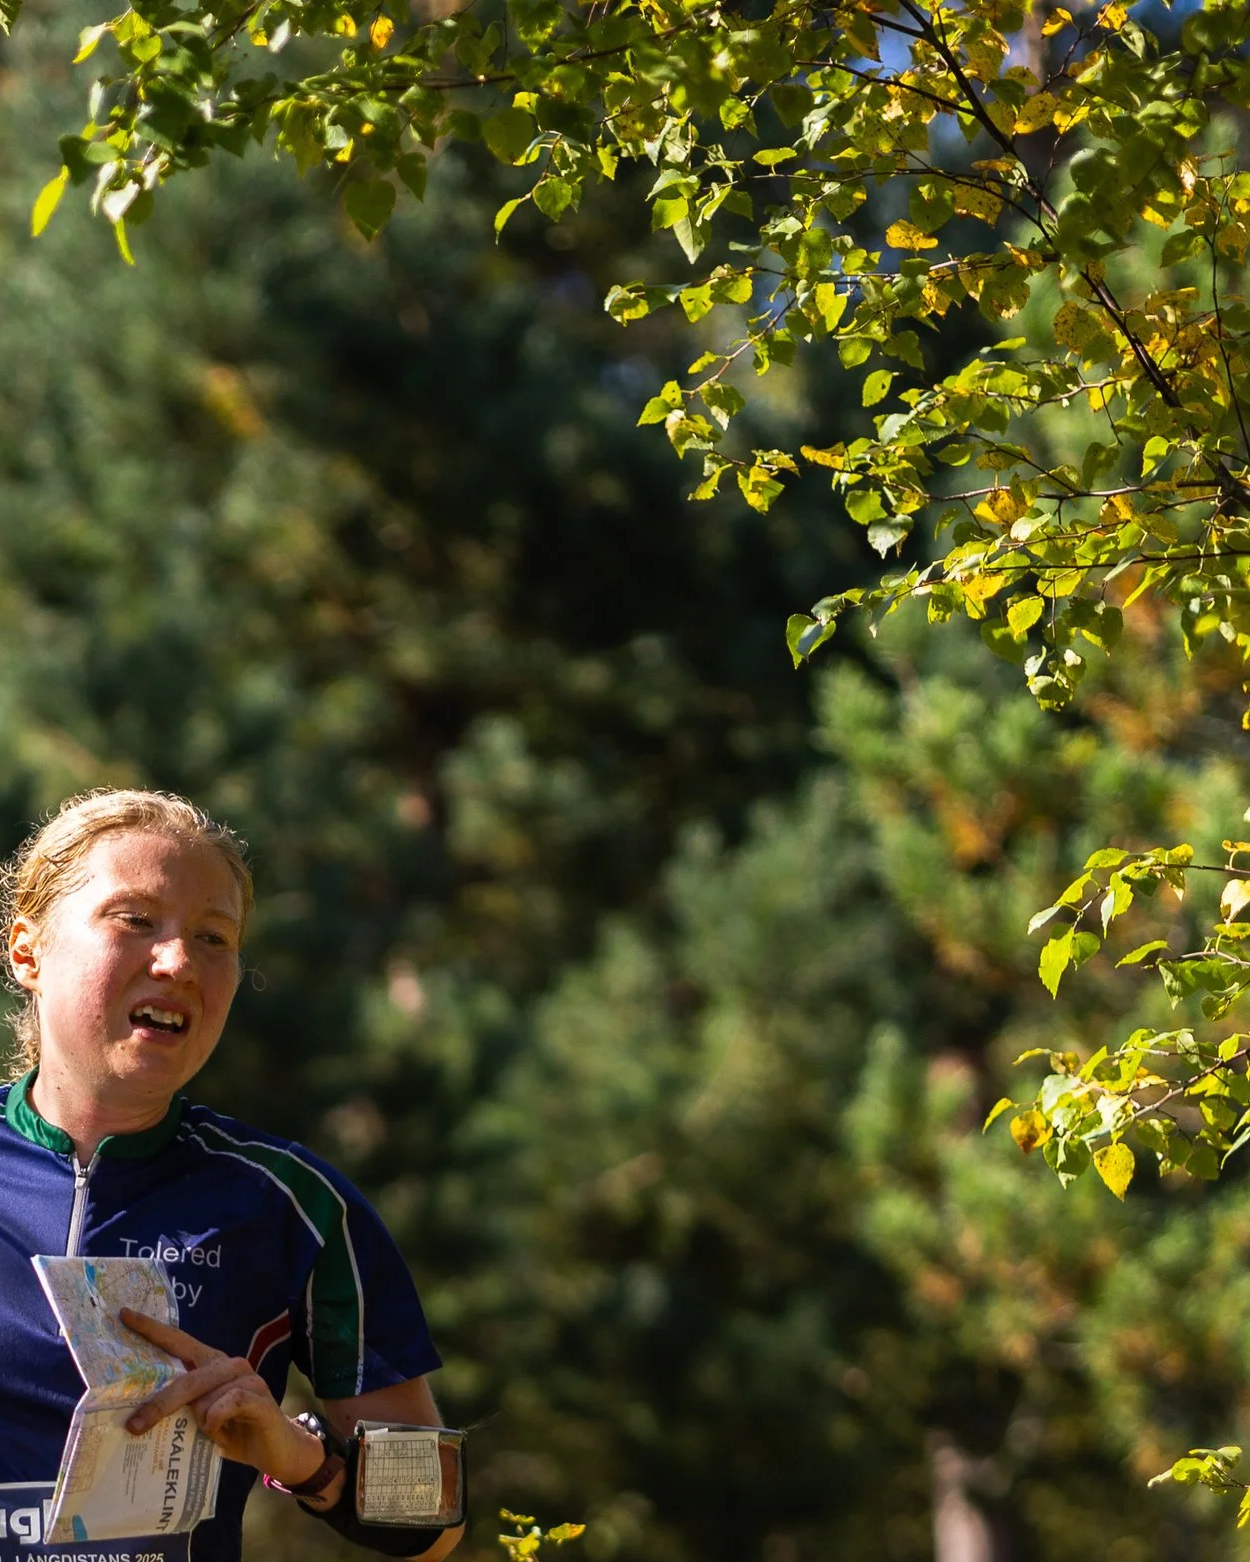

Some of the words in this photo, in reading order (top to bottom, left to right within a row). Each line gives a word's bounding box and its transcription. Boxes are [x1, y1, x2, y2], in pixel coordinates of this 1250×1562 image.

[119, 1237, 221, 1268] Tolered
[171, 1276, 203, 1307] by
[155, 1417, 188, 1532] SKÅLEKLINT
